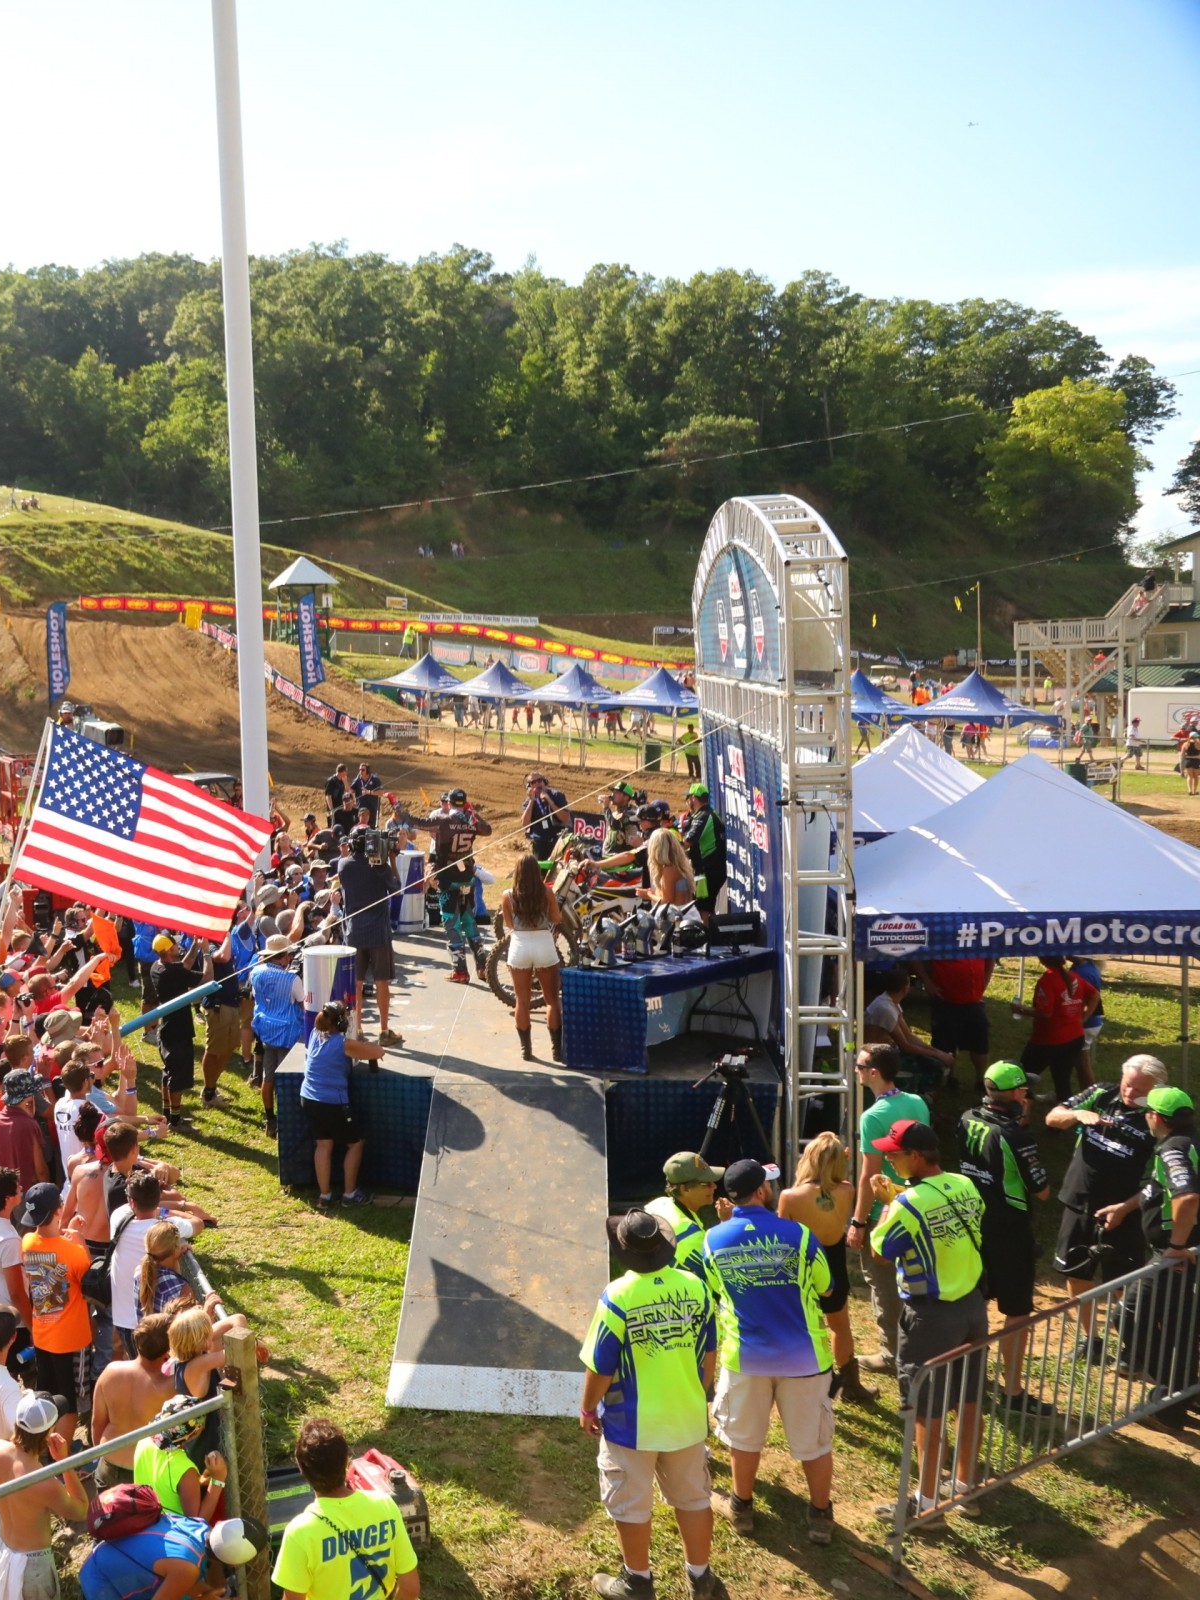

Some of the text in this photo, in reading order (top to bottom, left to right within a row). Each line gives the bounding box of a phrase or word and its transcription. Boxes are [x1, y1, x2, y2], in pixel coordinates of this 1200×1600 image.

[50, 609, 64, 694] HOLESHOT
[300, 603, 317, 684] HOLESHOT
[574, 817, 606, 841] Red
[451, 833, 474, 853] 15
[870, 934, 926, 942] MOTOCROSS
